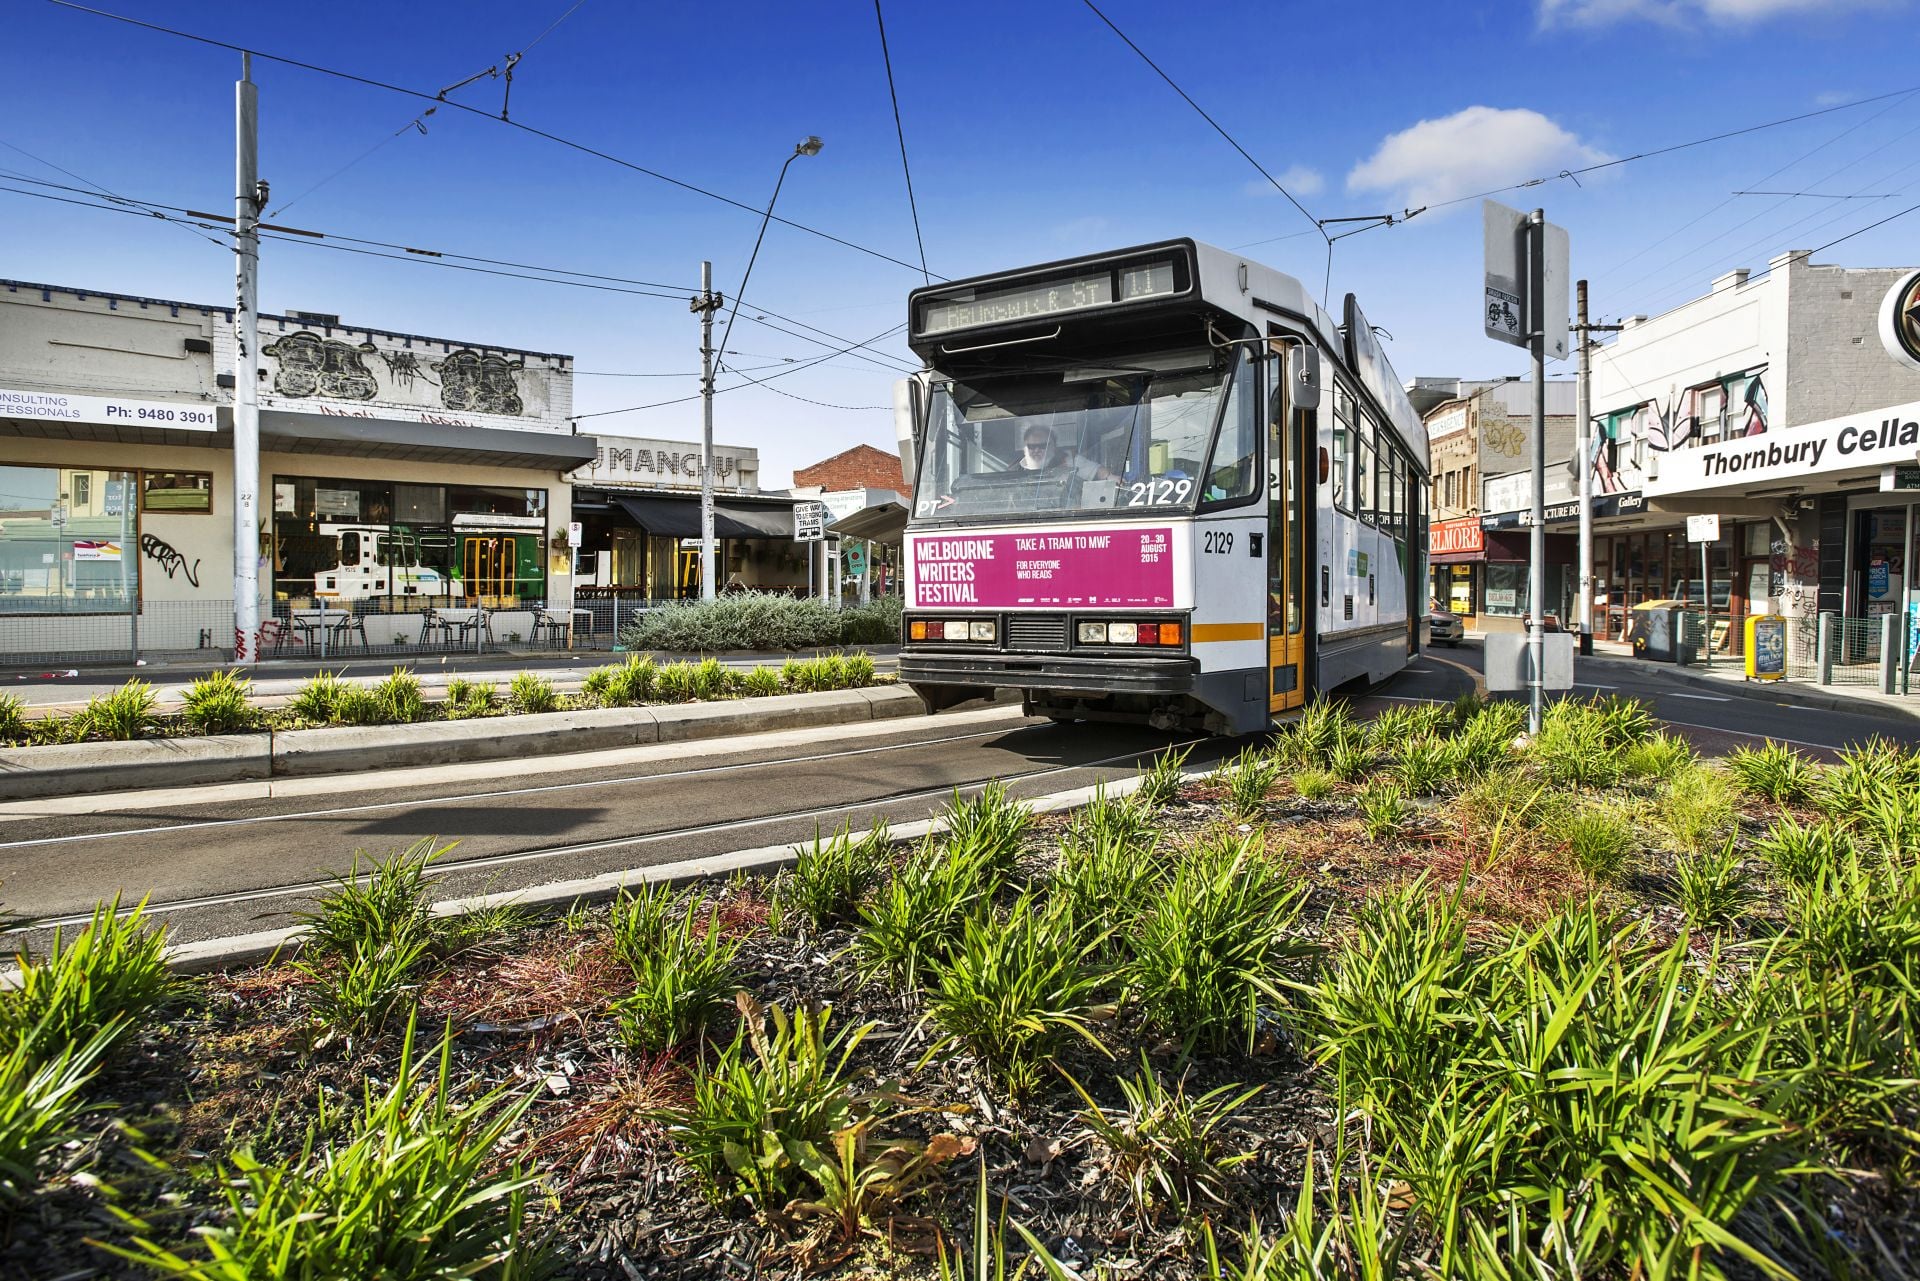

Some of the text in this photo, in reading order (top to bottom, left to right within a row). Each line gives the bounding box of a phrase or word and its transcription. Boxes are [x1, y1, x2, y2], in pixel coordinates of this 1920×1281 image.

[106, 405, 213, 424] Ph: 9480 3901
[1703, 418, 1919, 477] Thornbury Cella
[1128, 480, 1192, 507] 2129
[795, 503, 821, 513] GIVE WAY
[1618, 497, 1643, 508] Gallery
[802, 511, 822, 520] MERGING
[1543, 506, 1568, 520] ICTURE
[1569, 505, 1582, 517] BO
[798, 518, 819, 527] TRAMS
[1016, 535, 1111, 551] TAKE A TRAM TO MWF
[1204, 531, 1233, 555] 2129
[1430, 526, 1480, 551] ELMORE
[916, 540, 995, 561] MELBOURNE
[1140, 543, 1167, 553] AUGUST
[1016, 560, 1060, 570] FOR EVERYONE
[1141, 554, 1159, 563] 2015
[918, 562, 975, 582] WRITERS
[1016, 570, 1052, 579] WHO READS
[918, 583, 979, 603] FESTIVAL
